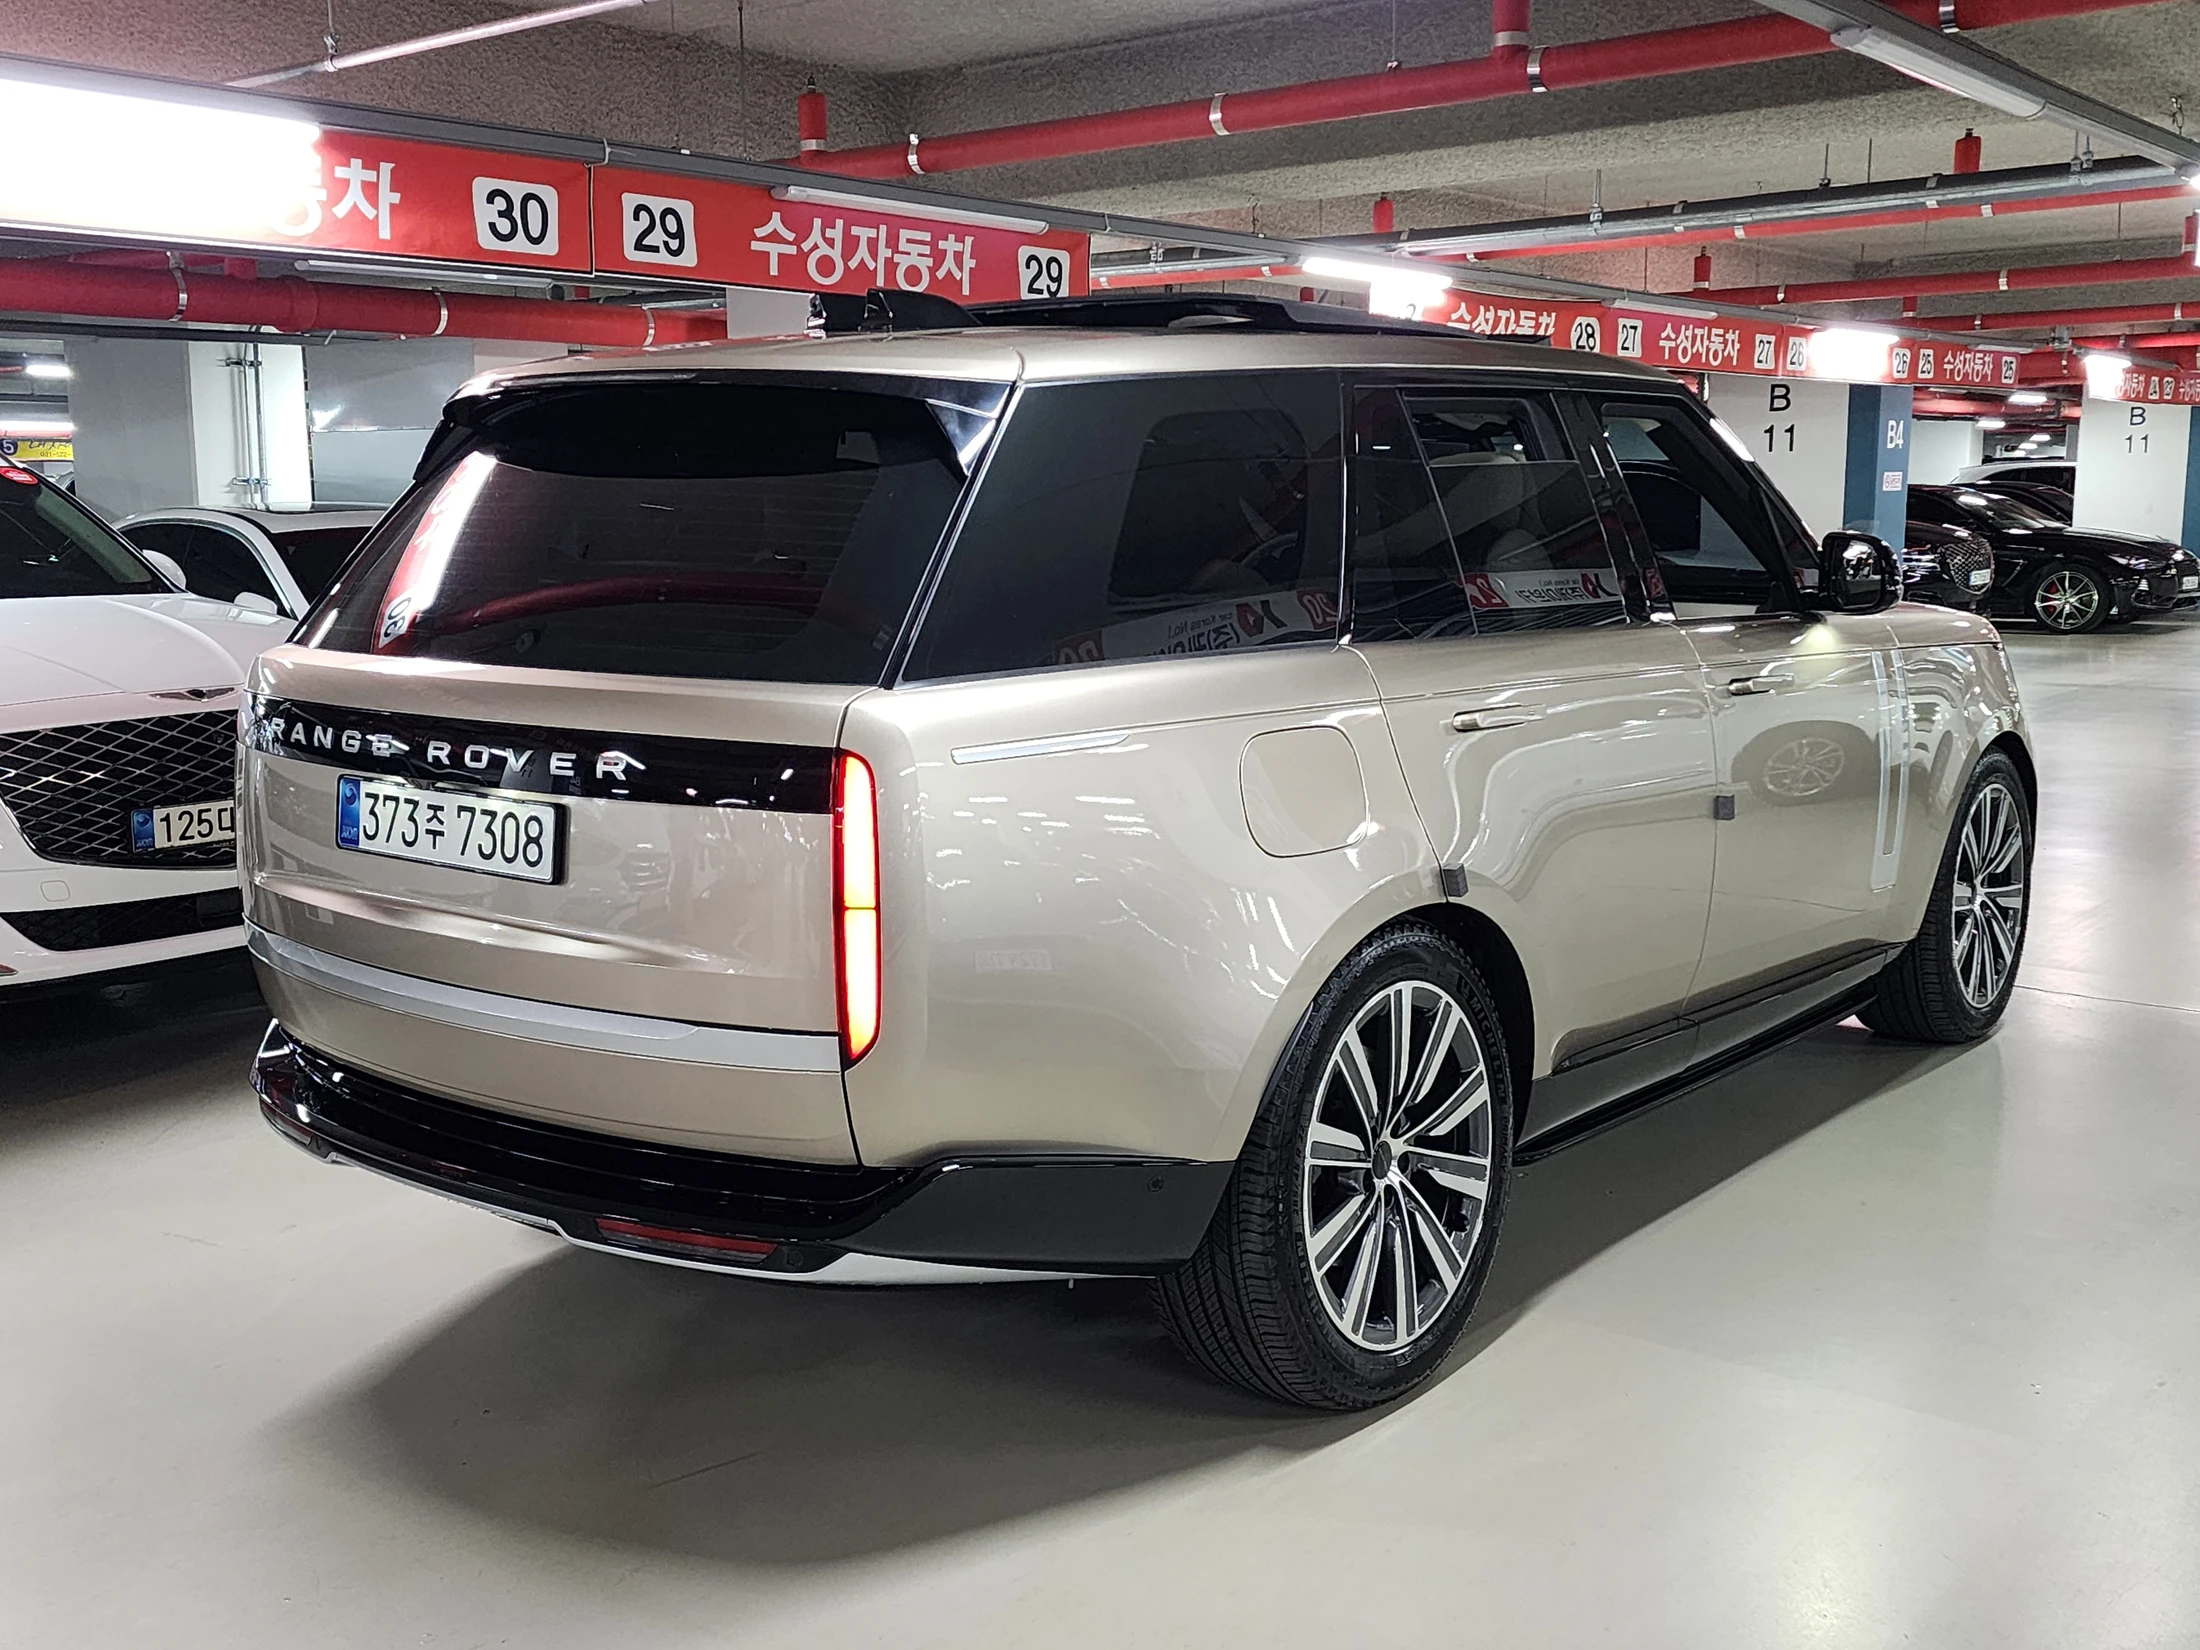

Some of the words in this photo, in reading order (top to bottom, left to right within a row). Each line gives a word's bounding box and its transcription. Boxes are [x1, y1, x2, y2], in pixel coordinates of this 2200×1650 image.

[485, 187, 549, 246] 30
[632, 203, 686, 258] 29
[750, 211, 976, 296] 수성자동차
[1025, 253, 1064, 298] 29
[1574, 322, 1597, 351] 28
[1620, 323, 1638, 352] 27
[1659, 322, 1740, 366] 수성자동차
[1756, 339, 1772, 364] 27
[1789, 341, 1805, 366] 26
[1894, 352, 1908, 374] 26
[1920, 352, 1932, 375] 25
[1943, 350, 1993, 382] 수성자동차
[2003, 360, 2014, 380] 25
[1769, 384, 1791, 412] B
[2130, 407, 2146, 425] B
[1764, 424, 1795, 452] 11
[1887, 420, 1904, 449] B4
[2125, 434, 2149, 453] 11
[270, 717, 392, 757] RANGE
[427, 741, 627, 781] ROVER
[363, 791, 446, 851] 373주
[456, 805, 544, 868] 7308
[1468, 996, 1507, 1099] MICHELIN
[1296, 1240, 1338, 1350] MICHELIN
